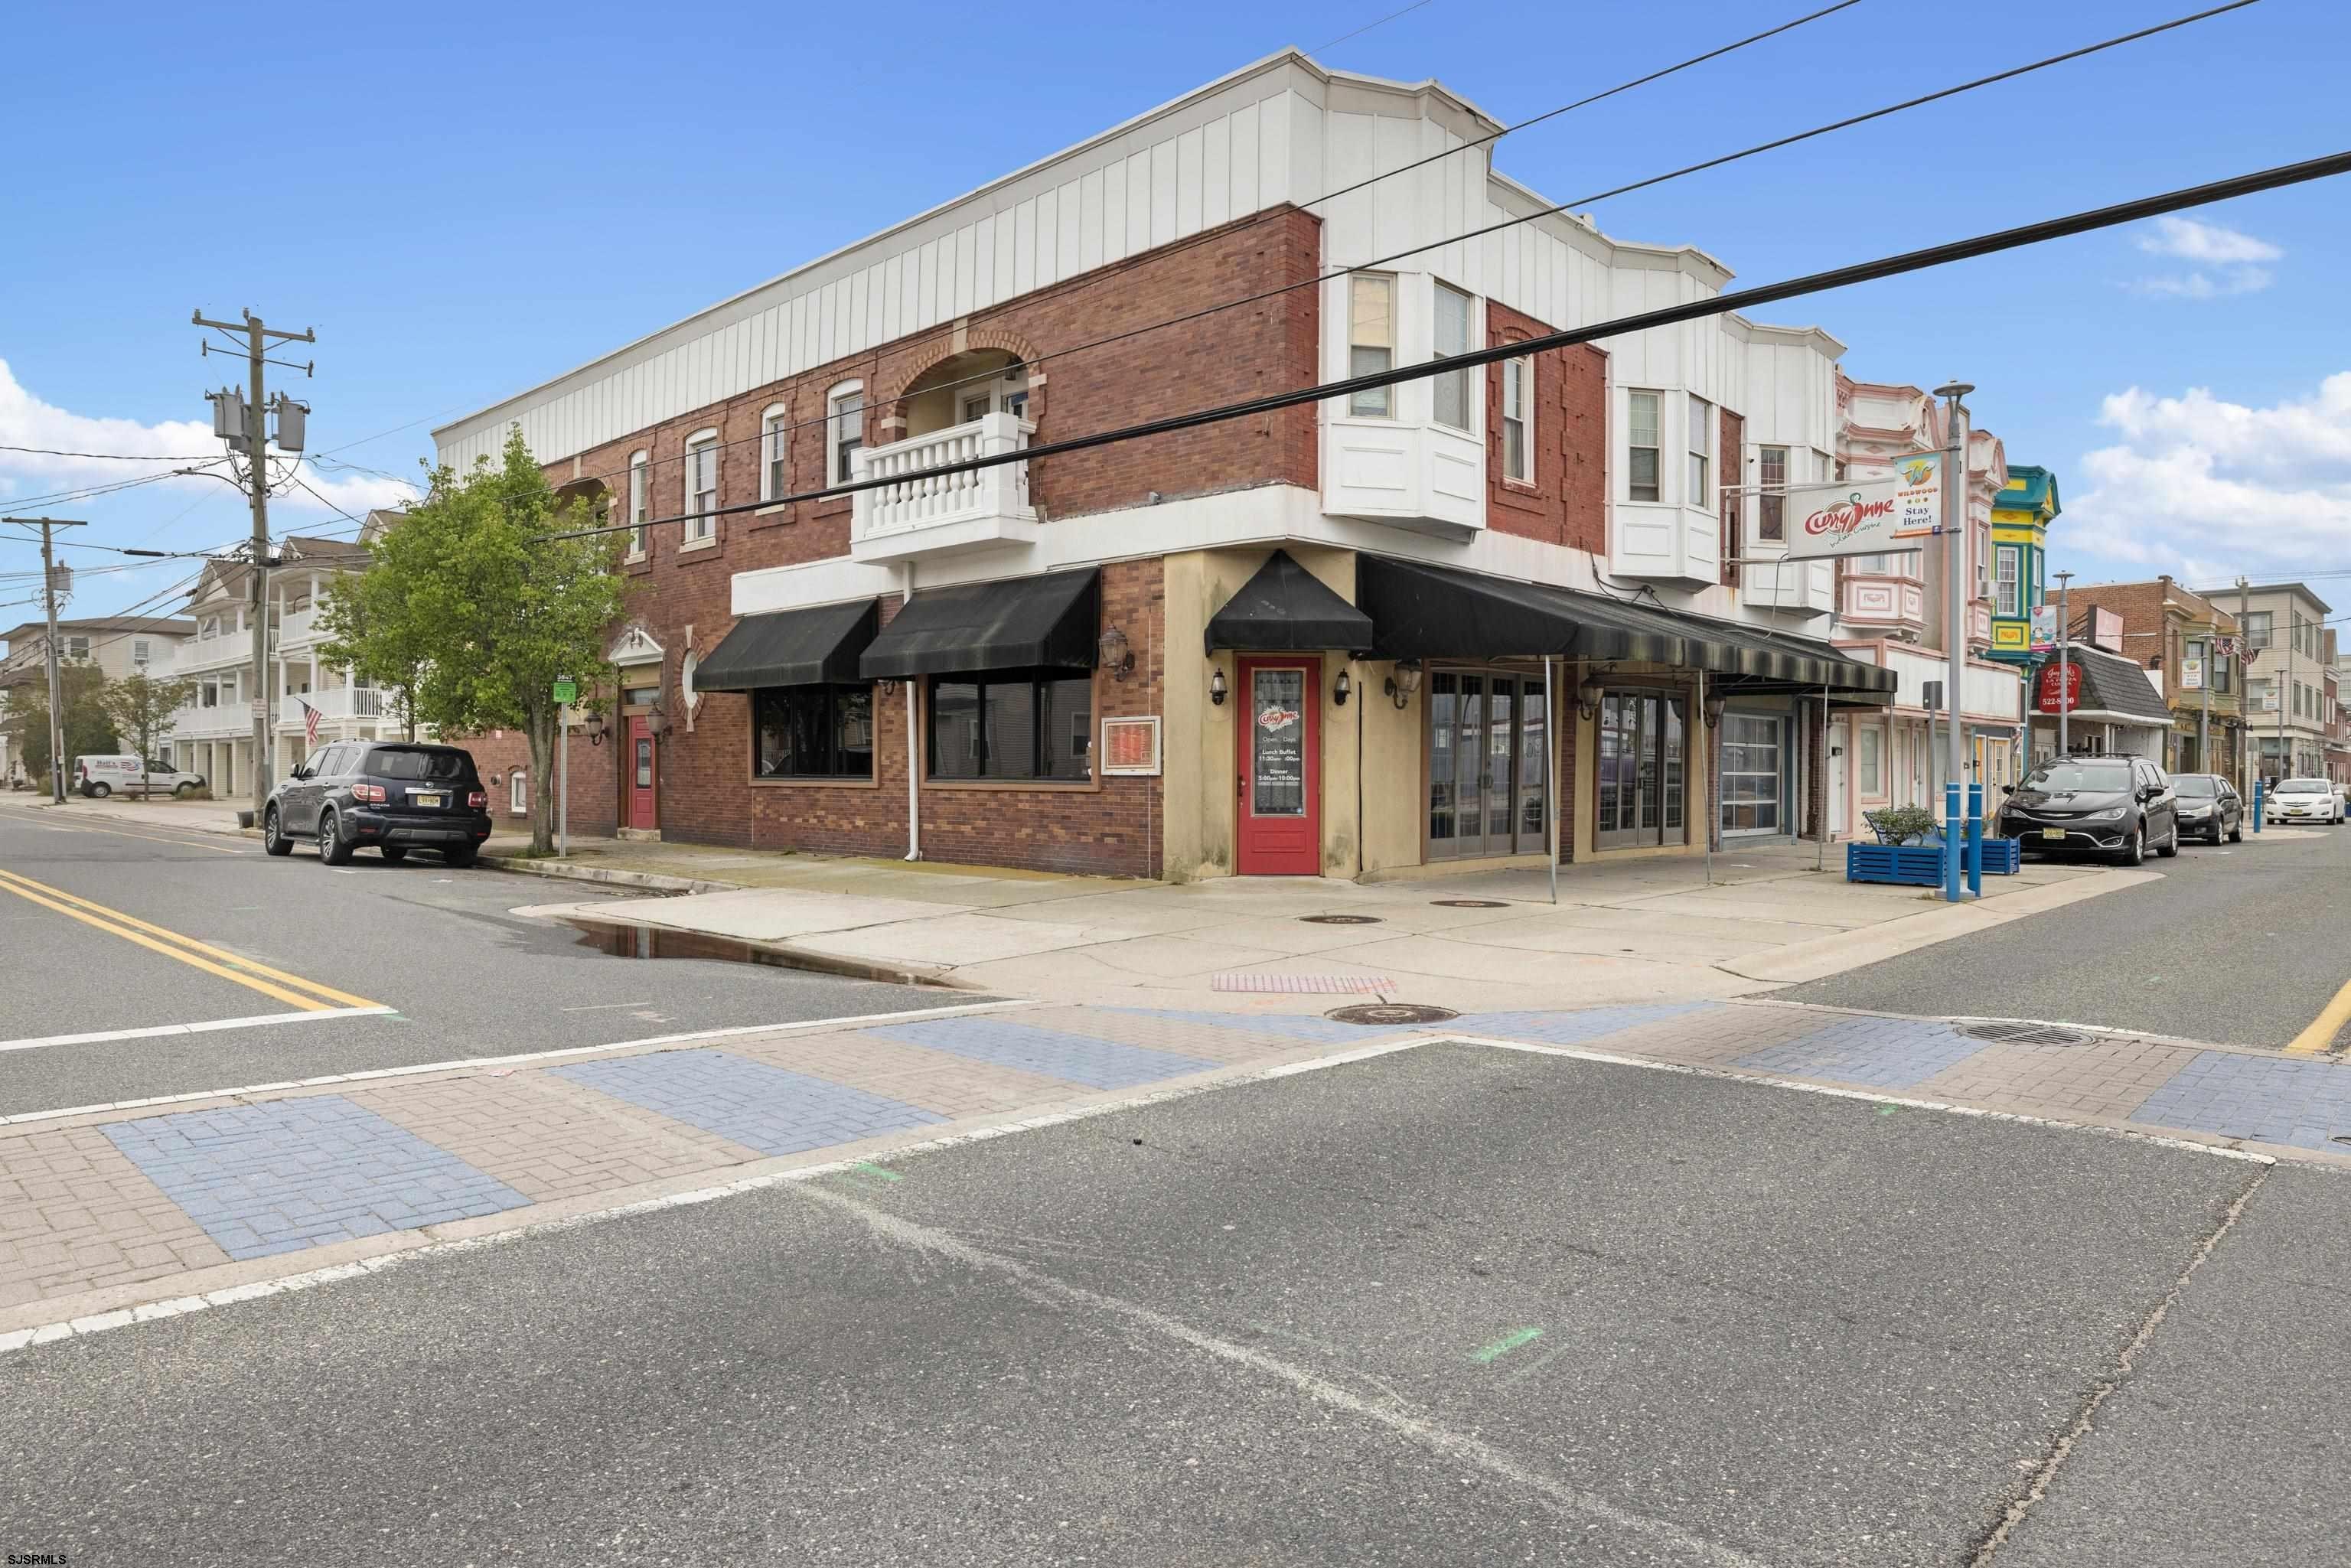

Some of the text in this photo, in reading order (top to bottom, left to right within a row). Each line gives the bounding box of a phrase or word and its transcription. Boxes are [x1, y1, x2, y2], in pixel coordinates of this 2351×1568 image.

[1898, 487, 1938, 497] WILDWOOD
[1906, 507, 1929, 516] Stay
[1805, 509, 1853, 535] Curry
[1903, 515, 1932, 526] Here!
